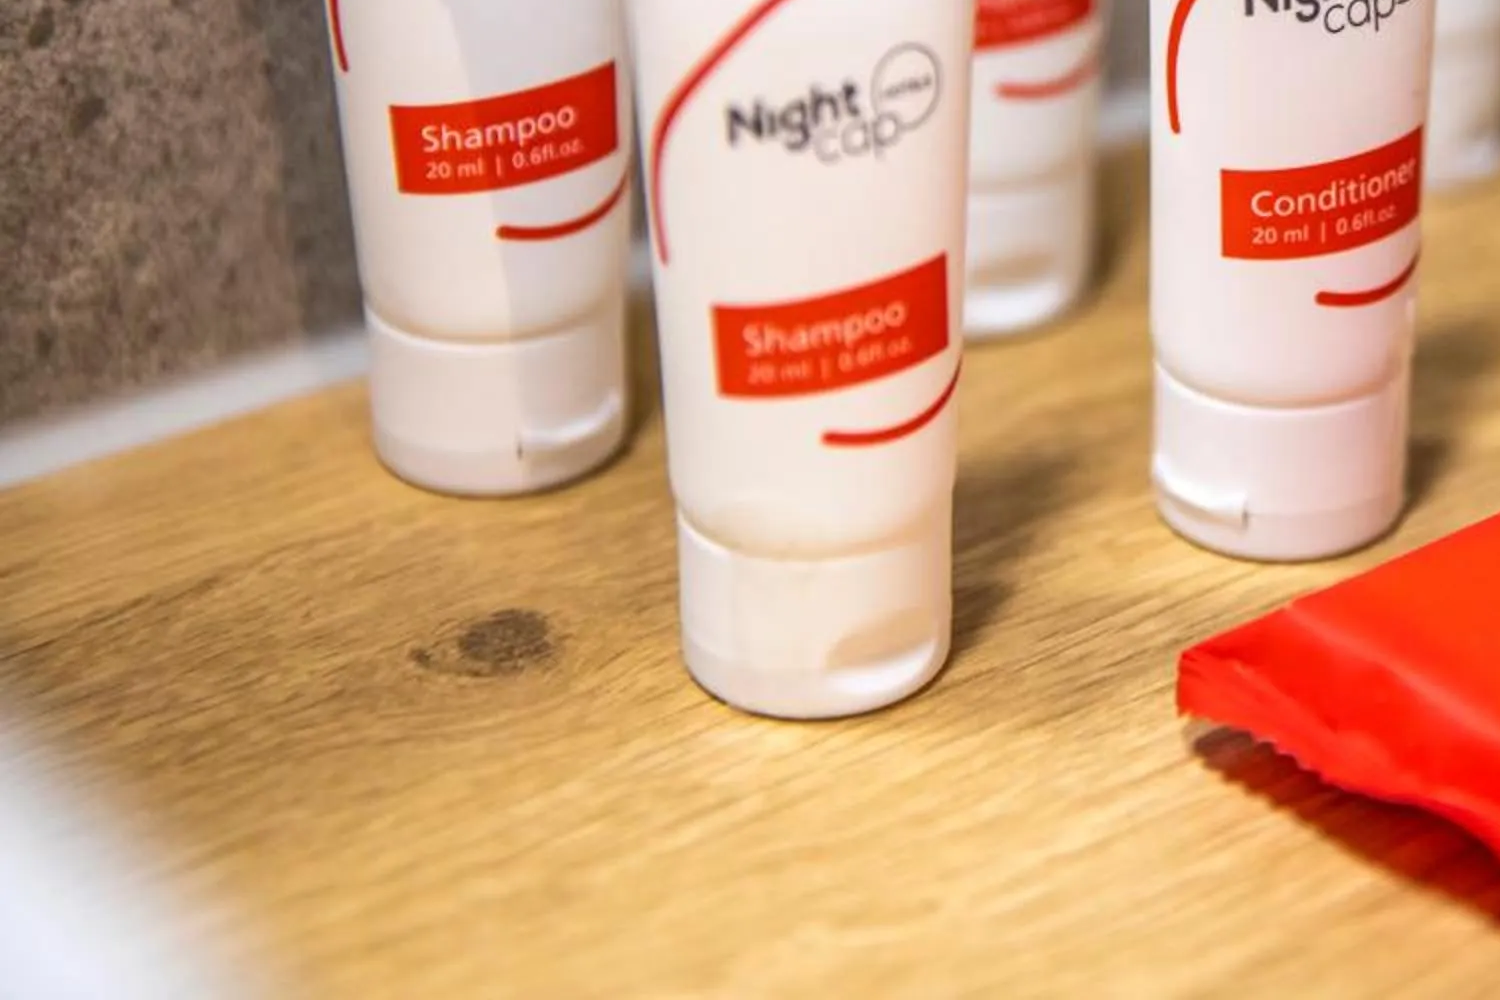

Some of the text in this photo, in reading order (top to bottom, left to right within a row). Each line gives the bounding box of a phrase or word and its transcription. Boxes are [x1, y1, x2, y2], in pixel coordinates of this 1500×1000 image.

[421, 105, 576, 153] Shampoo
[725, 81, 859, 151] Night
[814, 110, 901, 164] cap
[425, 160, 451, 180] 20
[457, 157, 484, 178] ml
[1250, 157, 1416, 218] Conditioner
[1252, 226, 1278, 245] 20
[1283, 224, 1309, 243] ml
[742, 300, 907, 358] Shampoo
